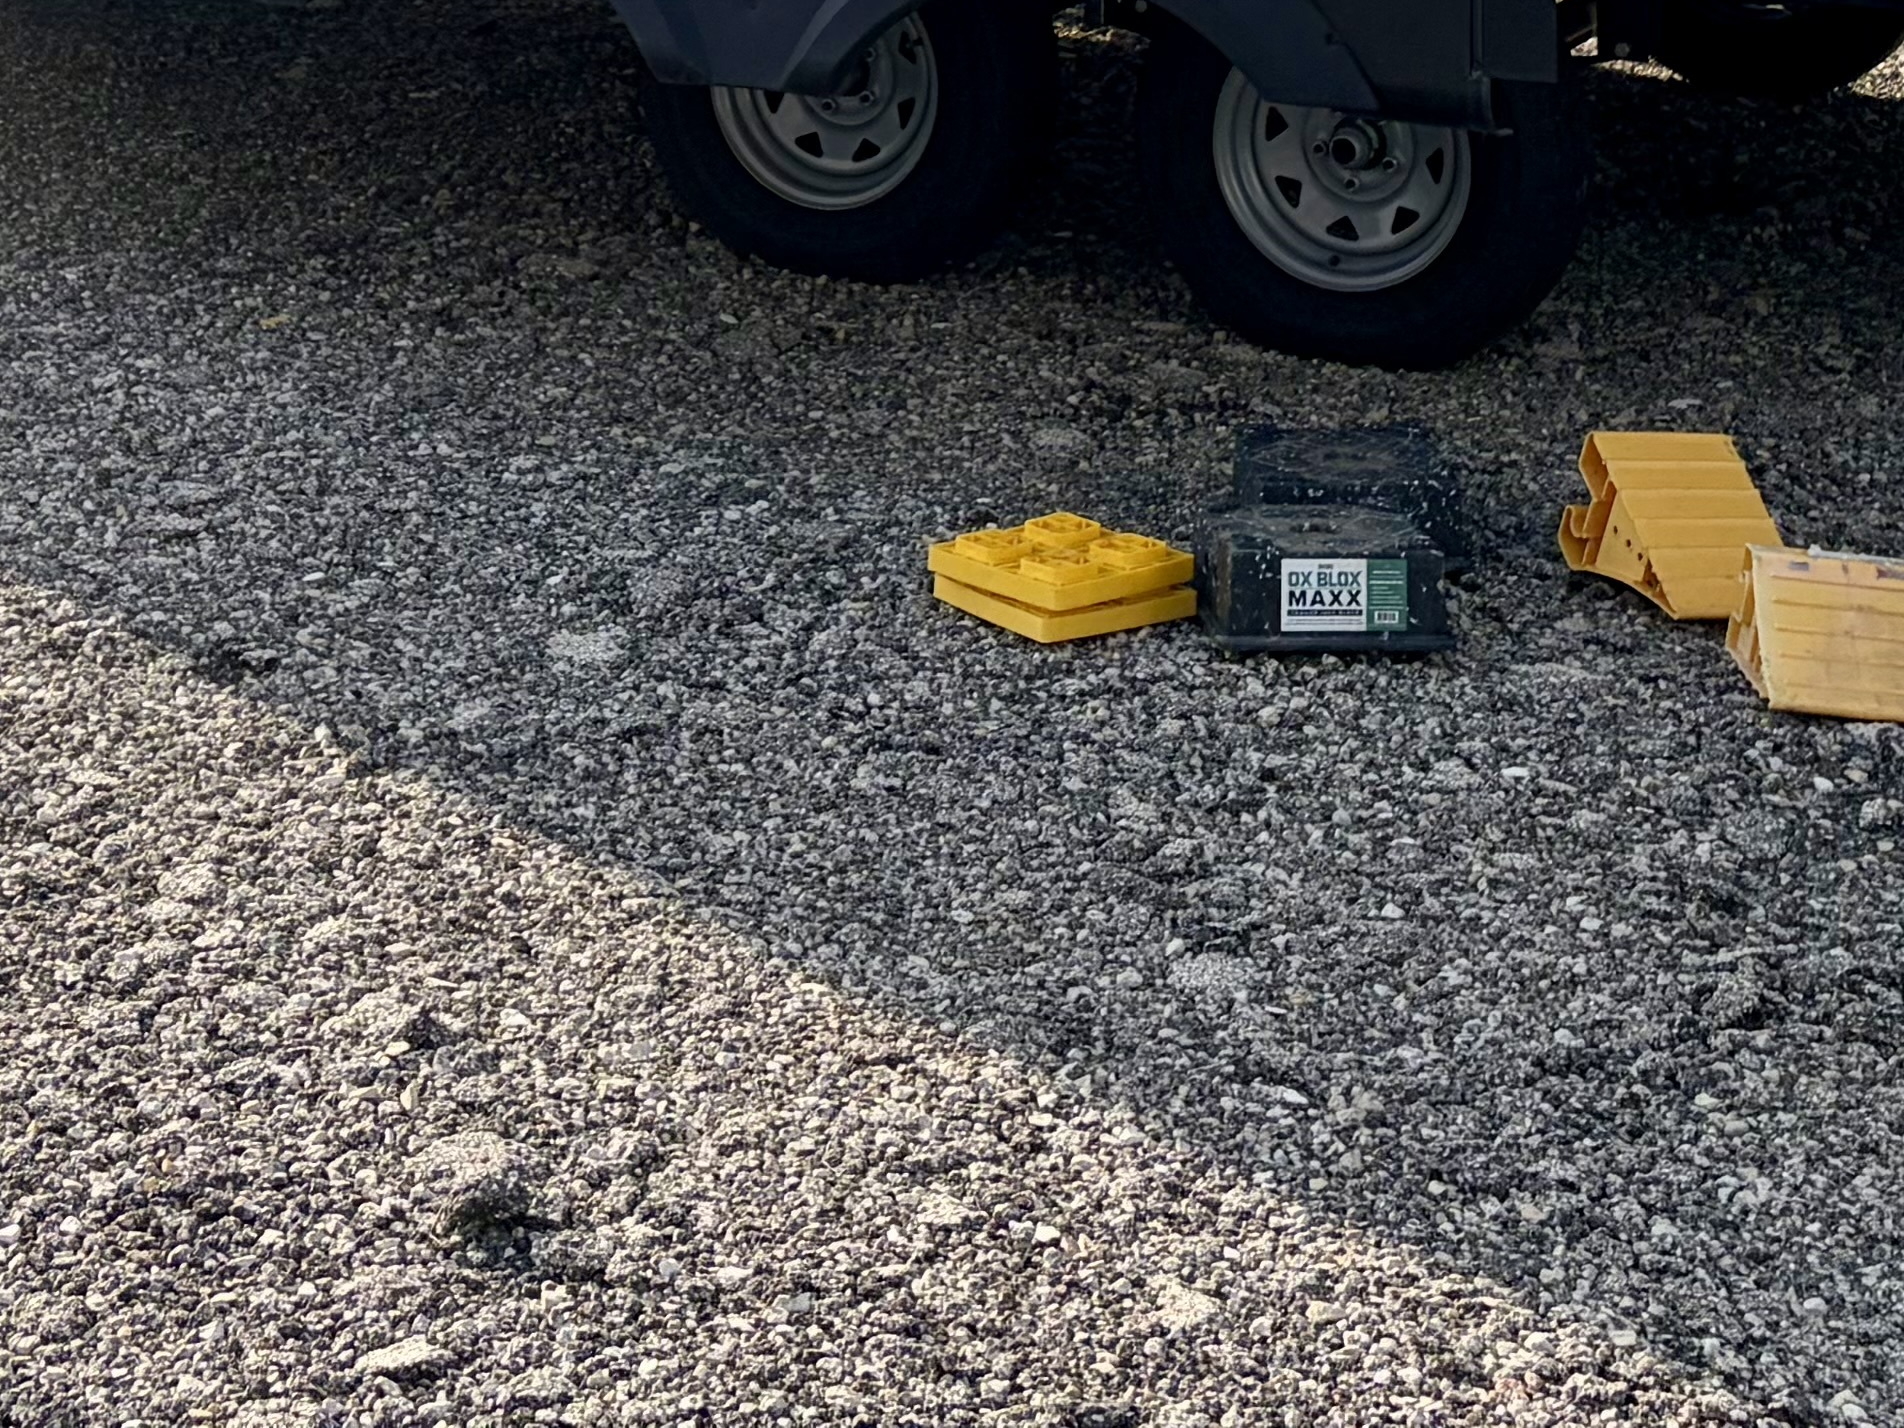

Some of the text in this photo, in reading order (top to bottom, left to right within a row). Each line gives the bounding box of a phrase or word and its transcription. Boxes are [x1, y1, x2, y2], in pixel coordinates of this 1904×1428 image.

[1287, 570, 1363, 588] OX BLOX
[1288, 590, 1362, 608] MAXX
